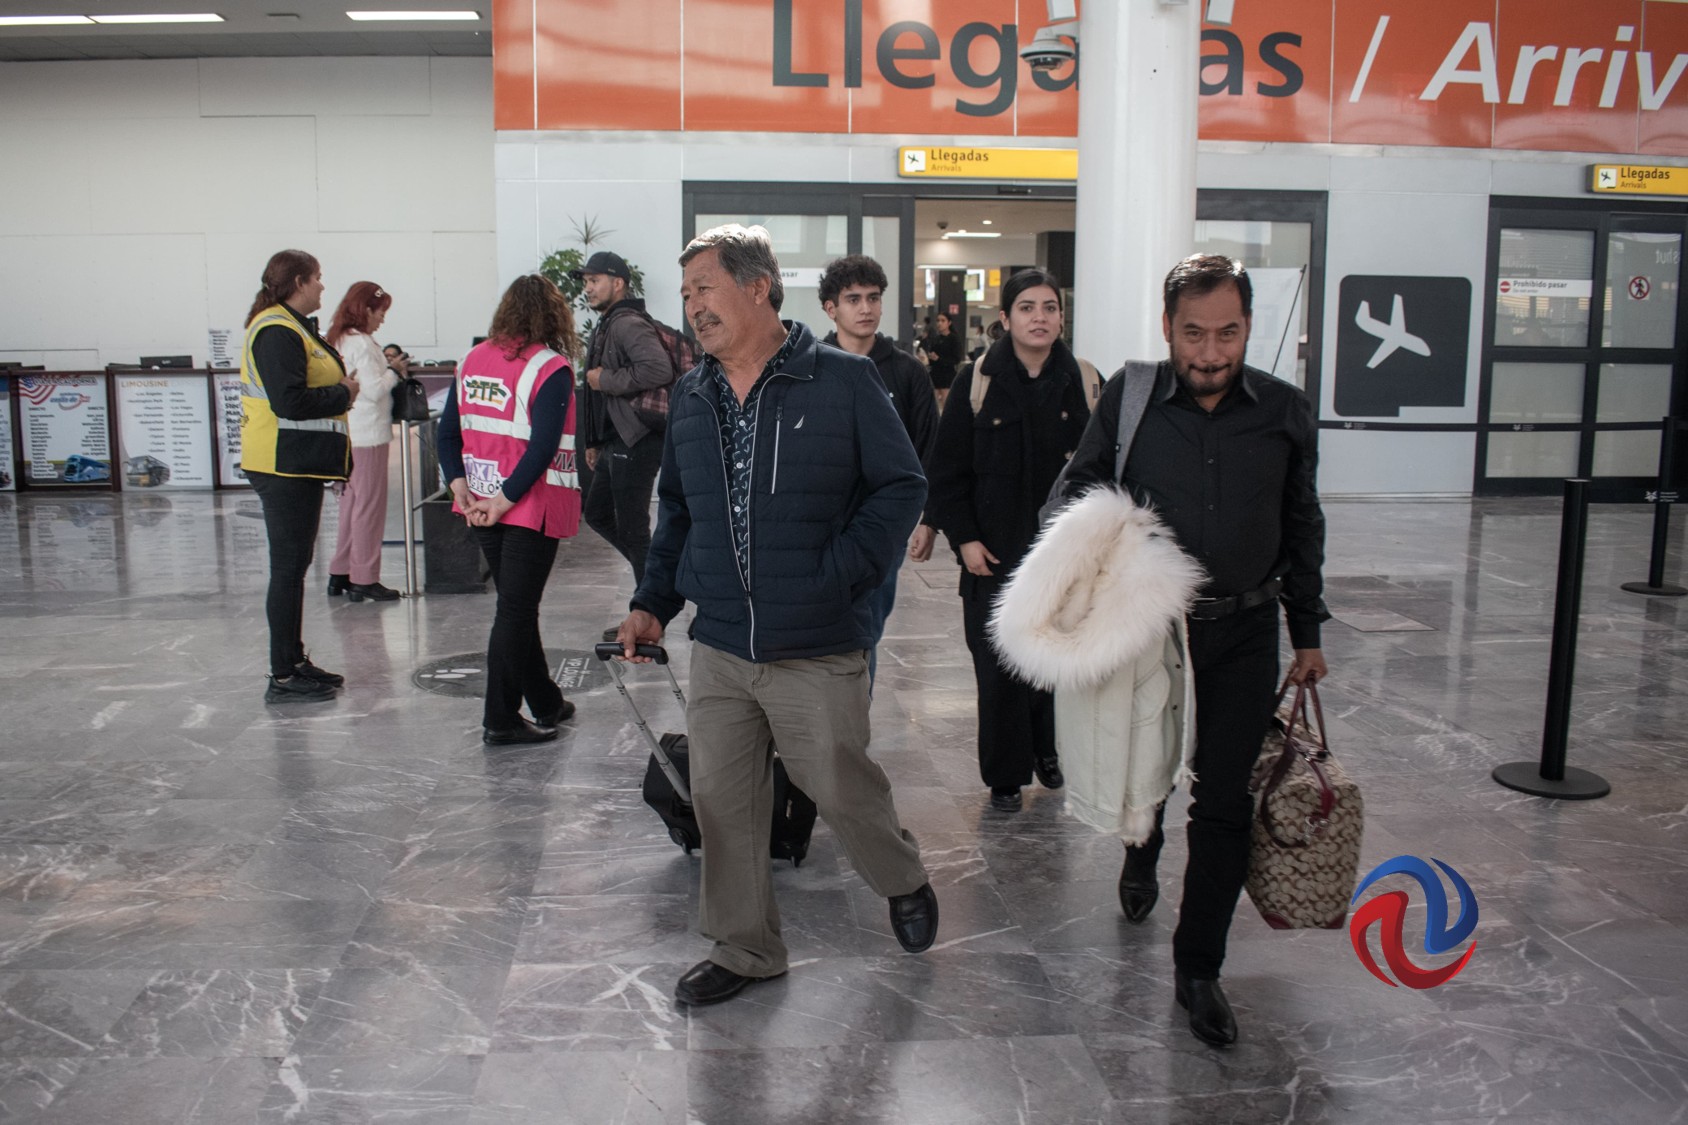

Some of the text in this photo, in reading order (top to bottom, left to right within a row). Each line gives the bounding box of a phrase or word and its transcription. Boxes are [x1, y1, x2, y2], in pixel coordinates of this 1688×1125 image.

[773, 0, 1304, 117] Llegas
[930, 149, 989, 164] Llegadas
[931, 164, 962, 172] Arrivals
[1620, 167, 1670, 182] Llegadas
[1513, 280, 1547, 288] Prohibido
